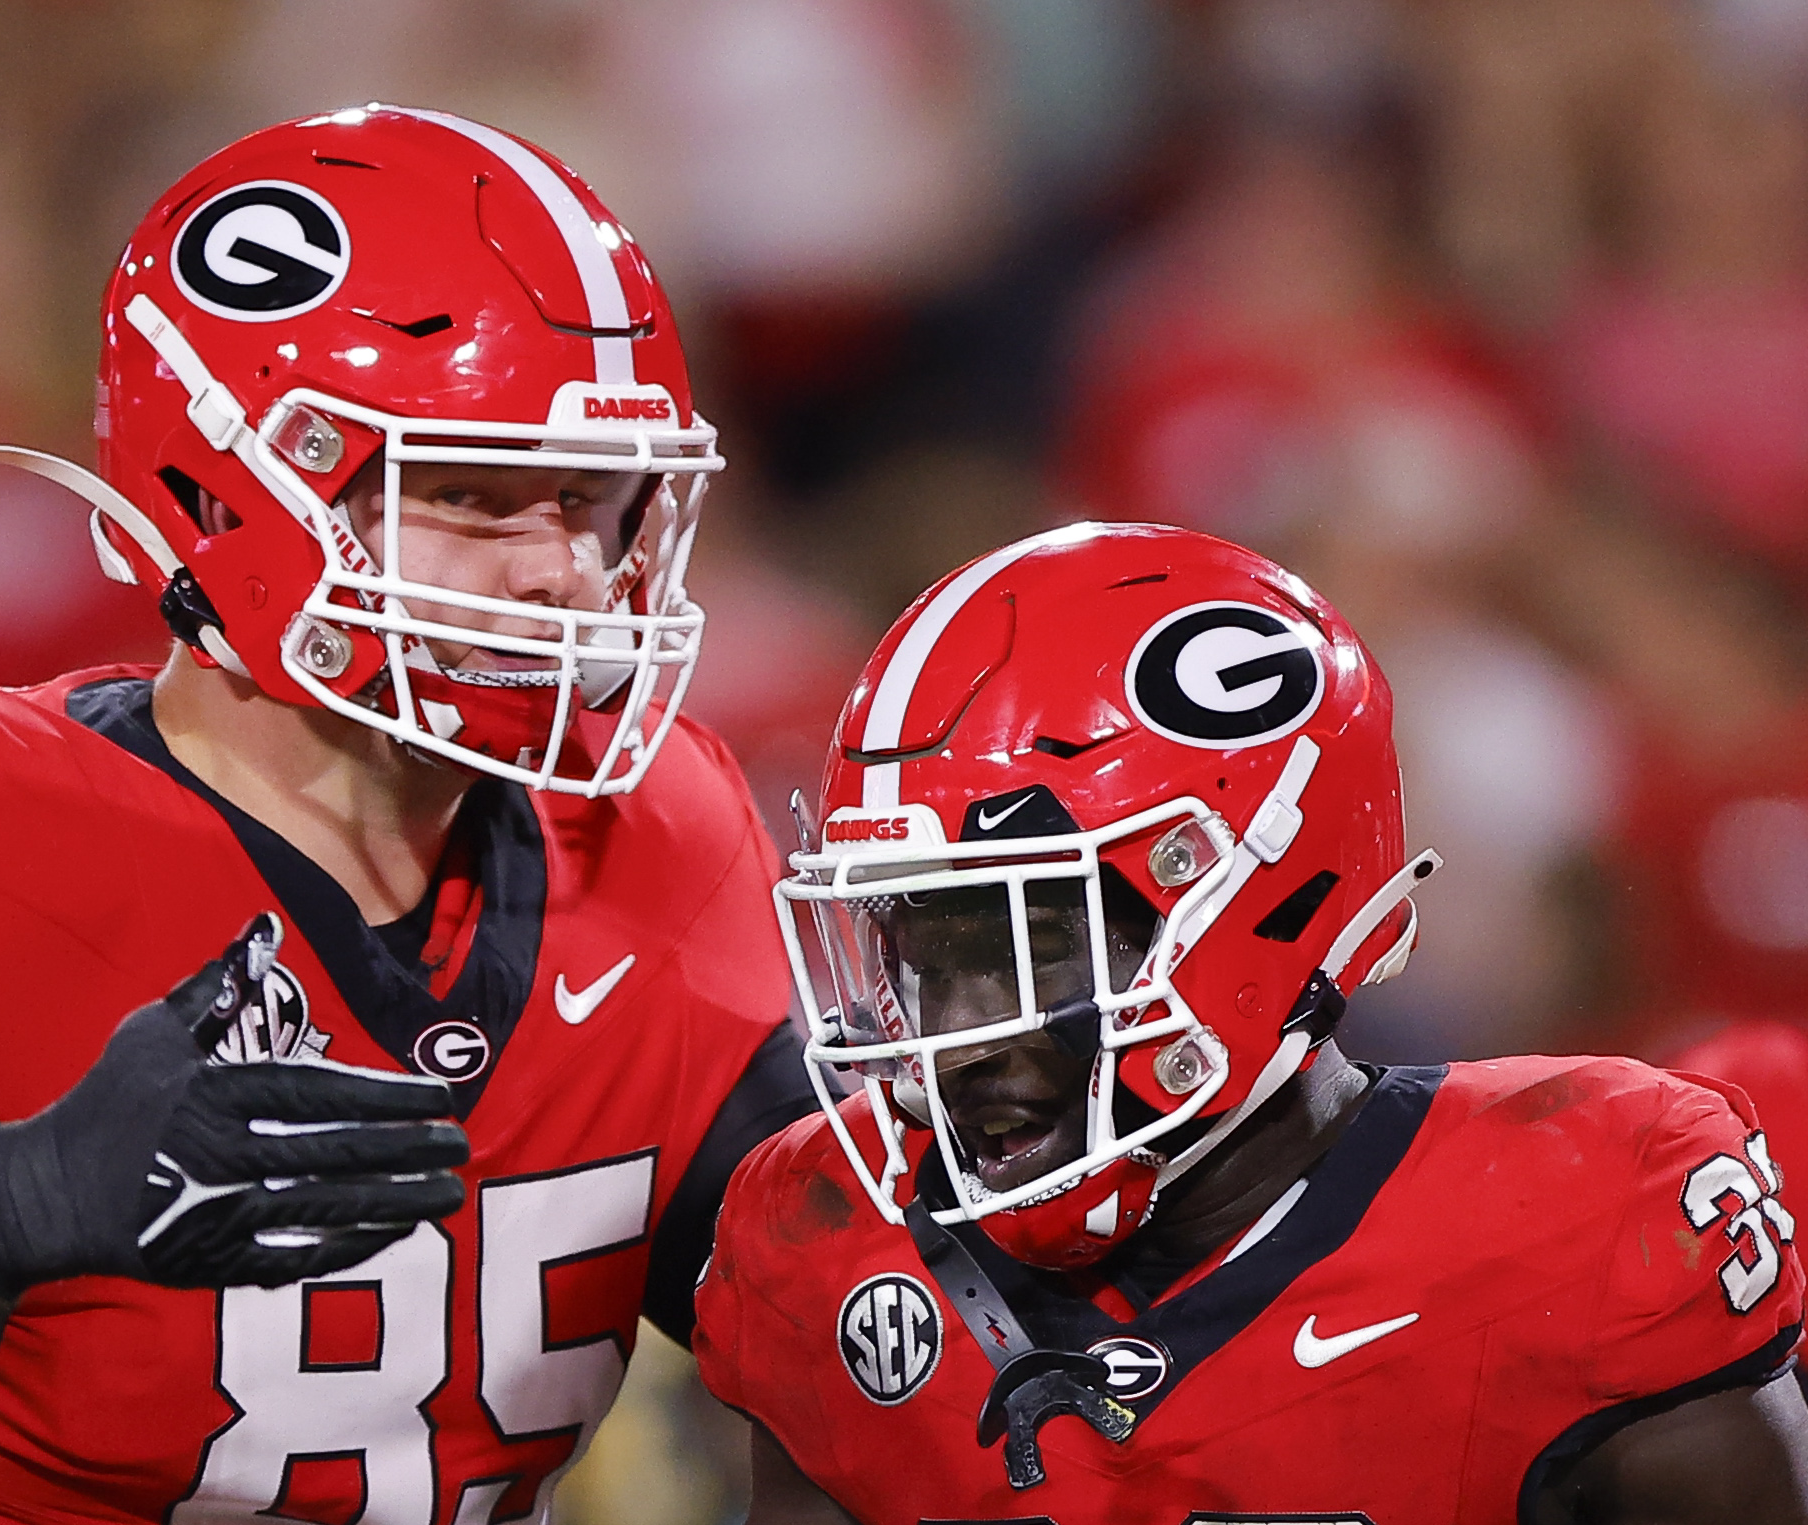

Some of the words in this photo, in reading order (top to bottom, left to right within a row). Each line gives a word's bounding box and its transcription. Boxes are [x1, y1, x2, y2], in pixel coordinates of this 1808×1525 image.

[178, 186, 343, 313] G
[1133, 606, 1319, 741] G
[417, 1025, 486, 1078] G
[847, 1282, 936, 1395] SEC
